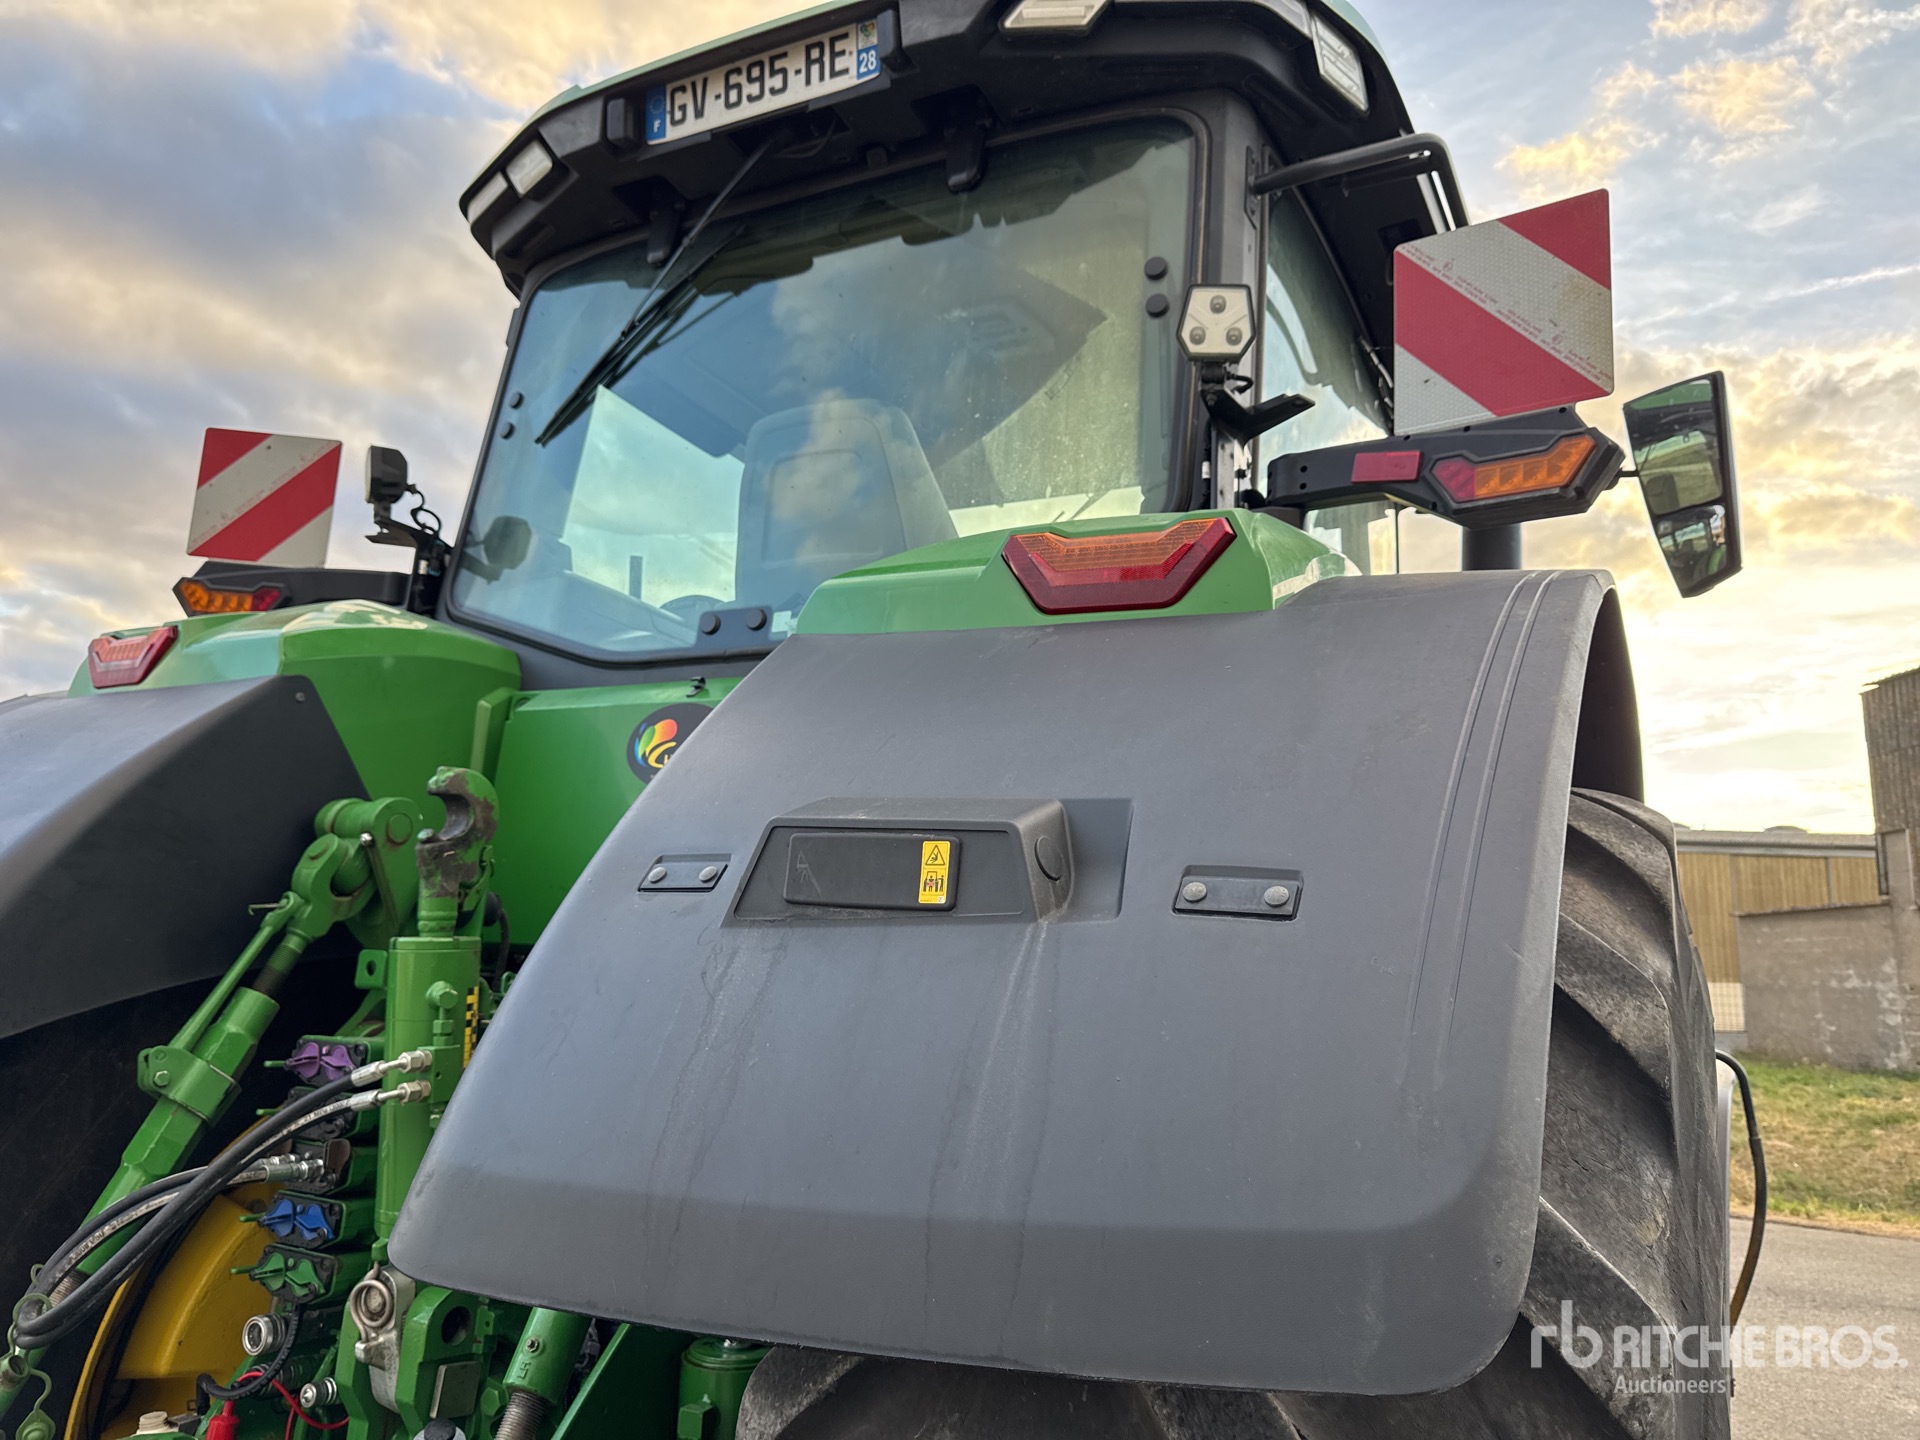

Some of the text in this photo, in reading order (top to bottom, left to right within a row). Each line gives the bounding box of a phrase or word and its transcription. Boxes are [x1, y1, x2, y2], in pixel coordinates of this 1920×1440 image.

[859, 50, 877, 73] 28
[669, 32, 850, 127] GV-695-RE
[653, 120, 661, 133] F
